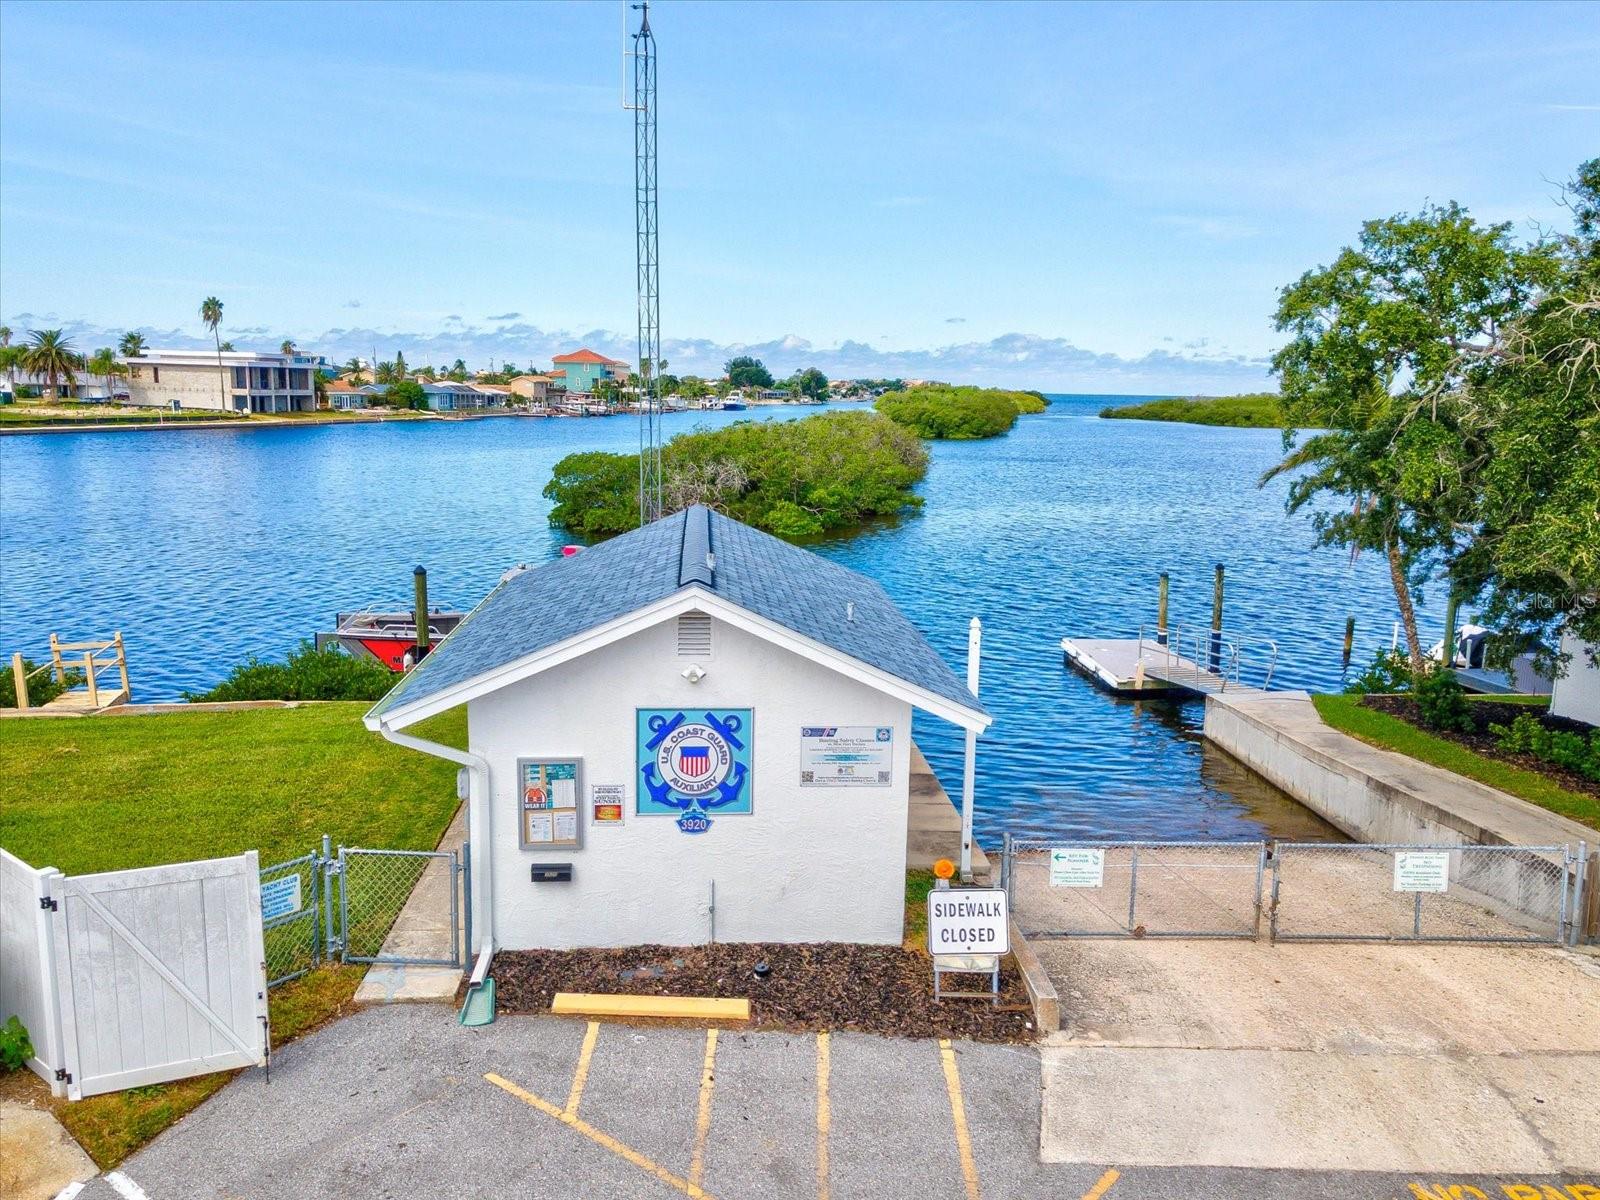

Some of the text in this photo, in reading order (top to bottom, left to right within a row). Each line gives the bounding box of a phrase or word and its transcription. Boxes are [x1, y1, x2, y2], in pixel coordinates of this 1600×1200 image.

[661, 727, 728, 765] U.S. COAST GUARD
[670, 776, 718, 792] AUXILIARY
[681, 819, 707, 830] 3920
[935, 902, 1002, 918] SIDEWALK
[941, 928, 995, 943] CLOSED
